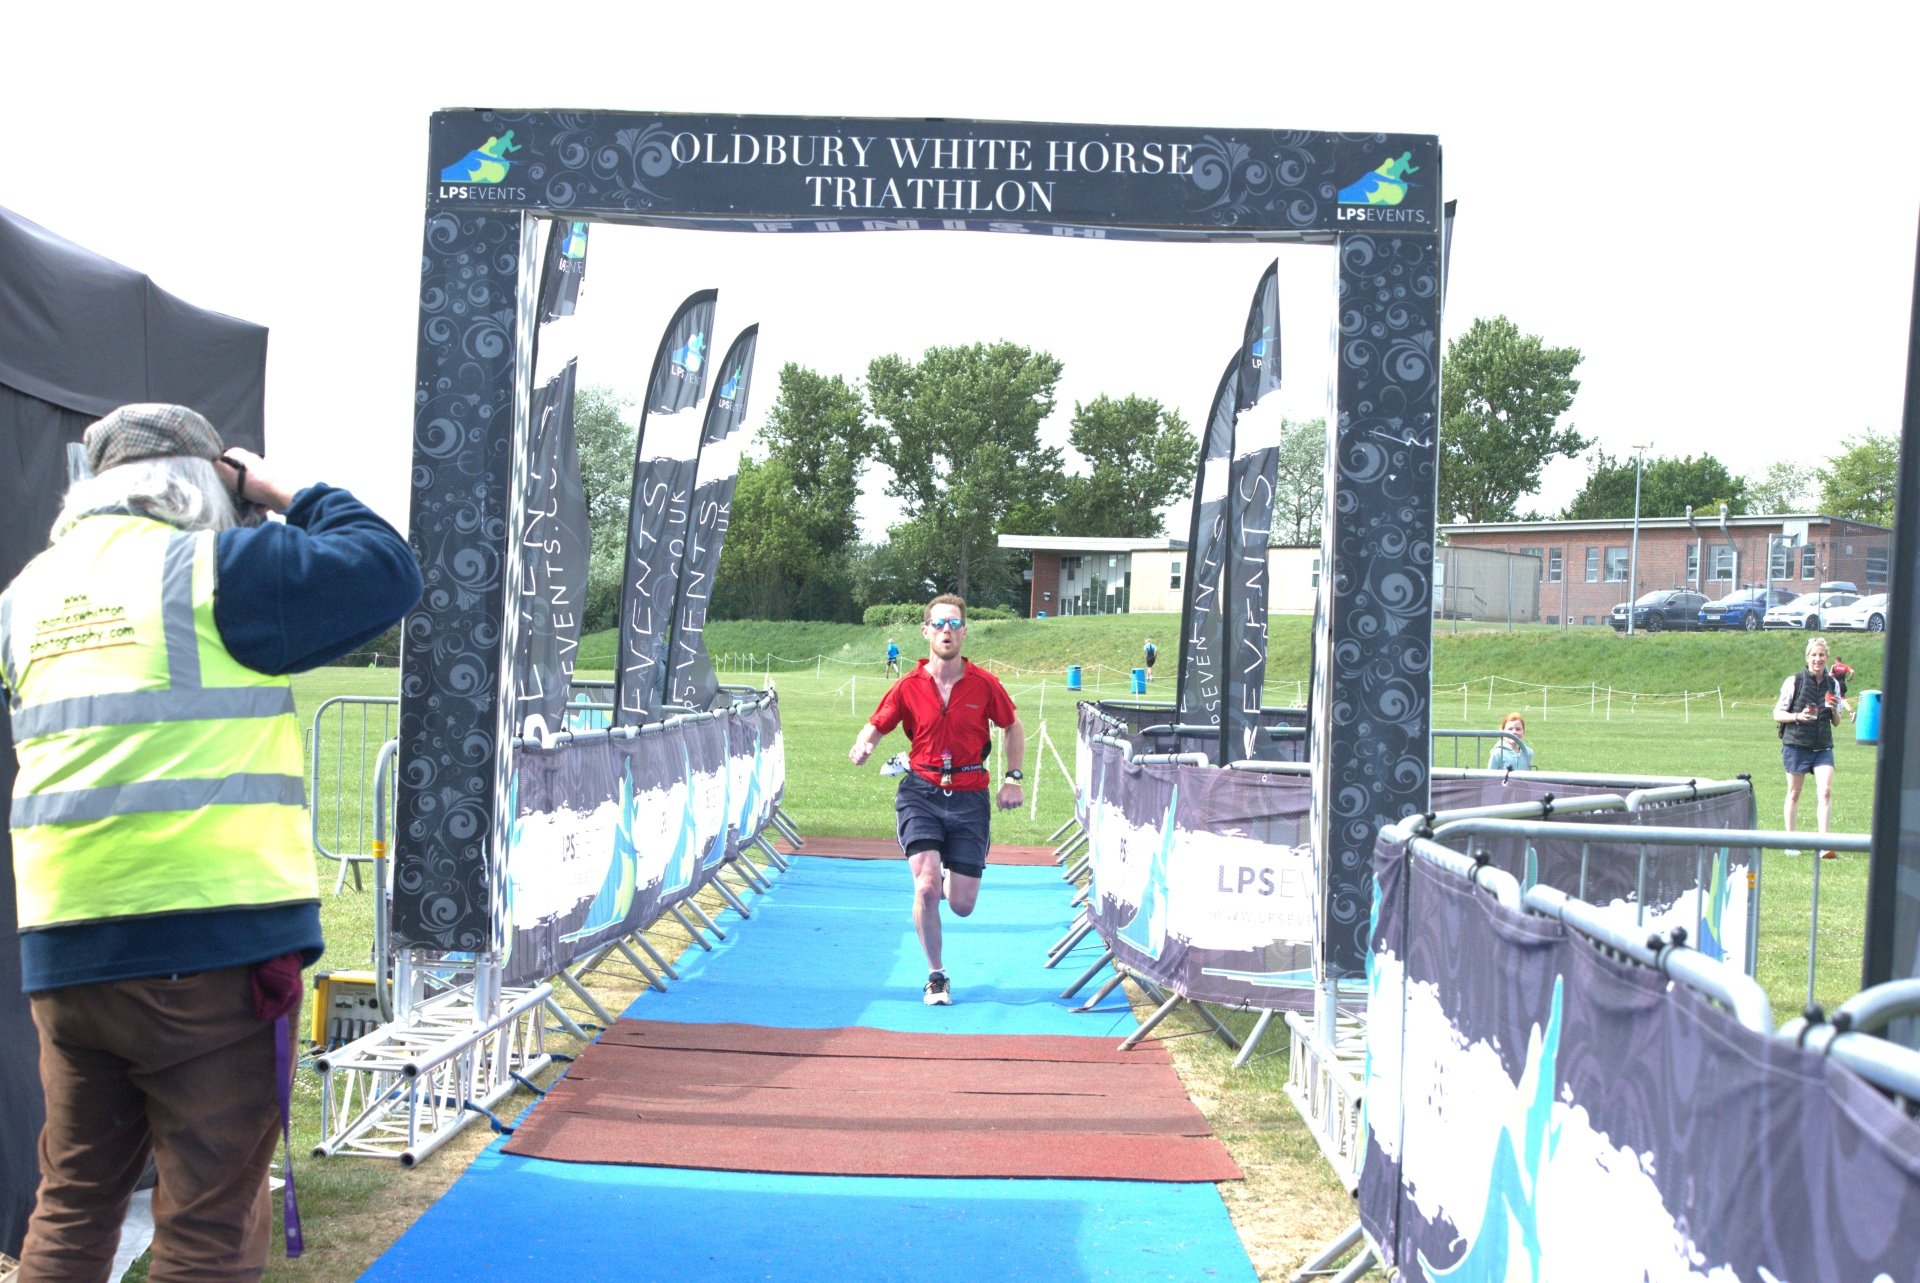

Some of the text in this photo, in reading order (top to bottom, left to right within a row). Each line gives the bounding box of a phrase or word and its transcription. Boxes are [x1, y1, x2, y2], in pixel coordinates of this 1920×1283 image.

[671, 131, 1194, 175] OLDBURY WHITE HORSE
[440, 186, 526, 201] LPSEVENTS
[805, 176, 1057, 213] TRIATHLON
[1337, 207, 1425, 222] LPSEVENTS
[752, 219, 1106, 239] FINISH
